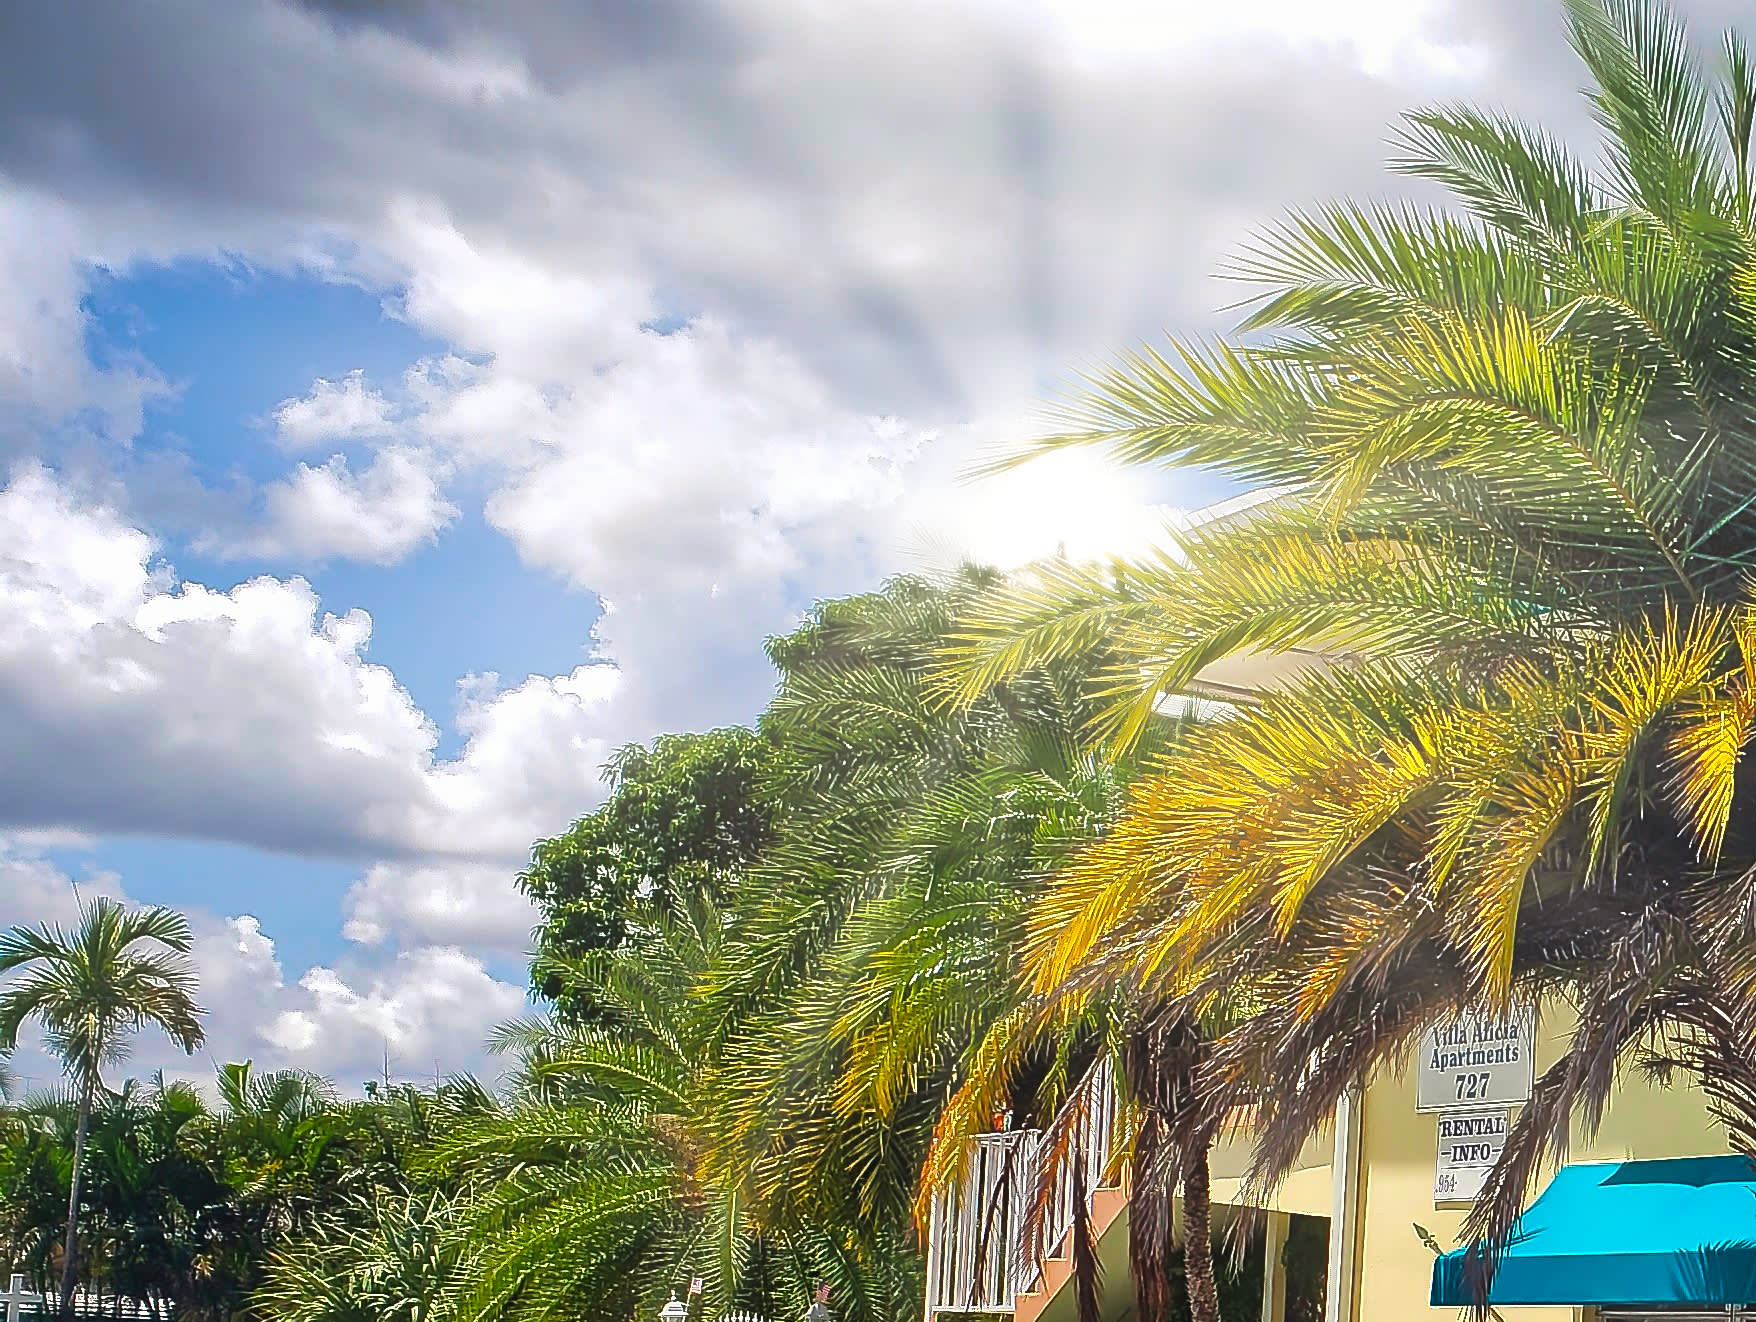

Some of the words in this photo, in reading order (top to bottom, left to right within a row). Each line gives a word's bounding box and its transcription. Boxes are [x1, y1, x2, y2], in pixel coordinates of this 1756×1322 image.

[1433, 1022, 1468, 1047] Villa
[1429, 1043, 1519, 1073] Apartments
[1455, 1072, 1491, 1100] 727
[1440, 1117, 1505, 1138] RENTAL
